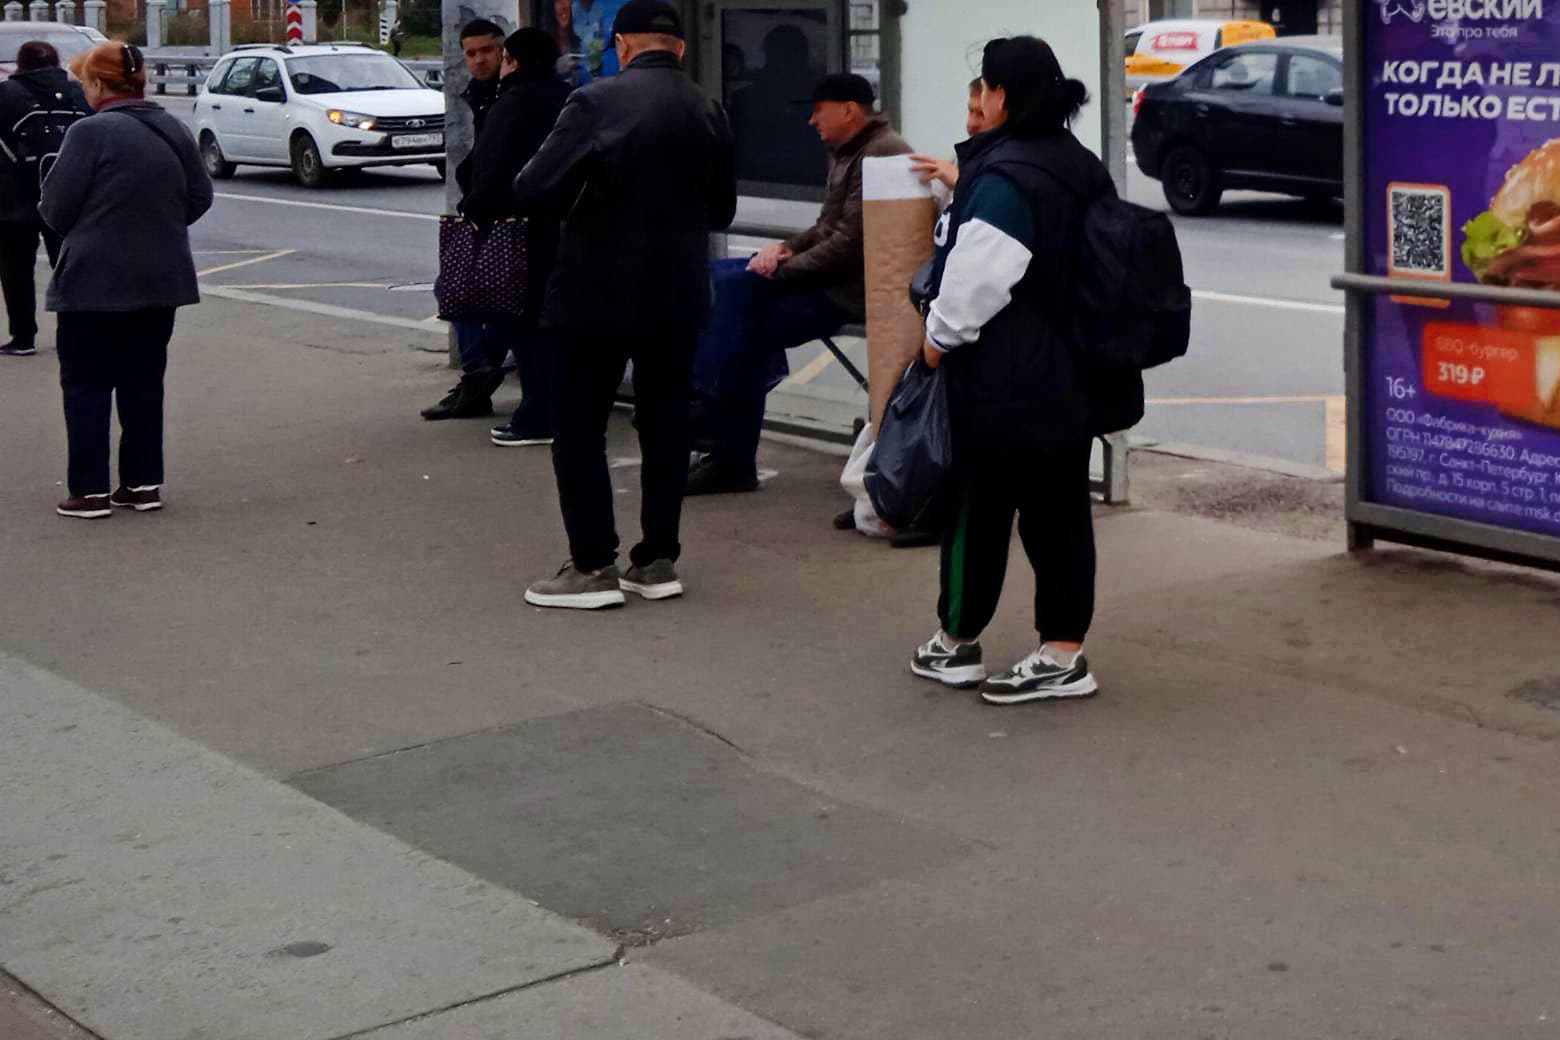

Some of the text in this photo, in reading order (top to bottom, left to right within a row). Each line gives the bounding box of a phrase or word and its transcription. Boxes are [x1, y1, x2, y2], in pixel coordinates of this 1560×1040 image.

[1486, 24, 1518, 38] тебя
[1382, 61, 1484, 90] КОГДА
[1489, 62, 1532, 86] НЕ
[1384, 92, 1501, 119] ТОЛЬКО
[1385, 376, 1416, 399] 16+
[1385, 407, 1415, 424] ООО
